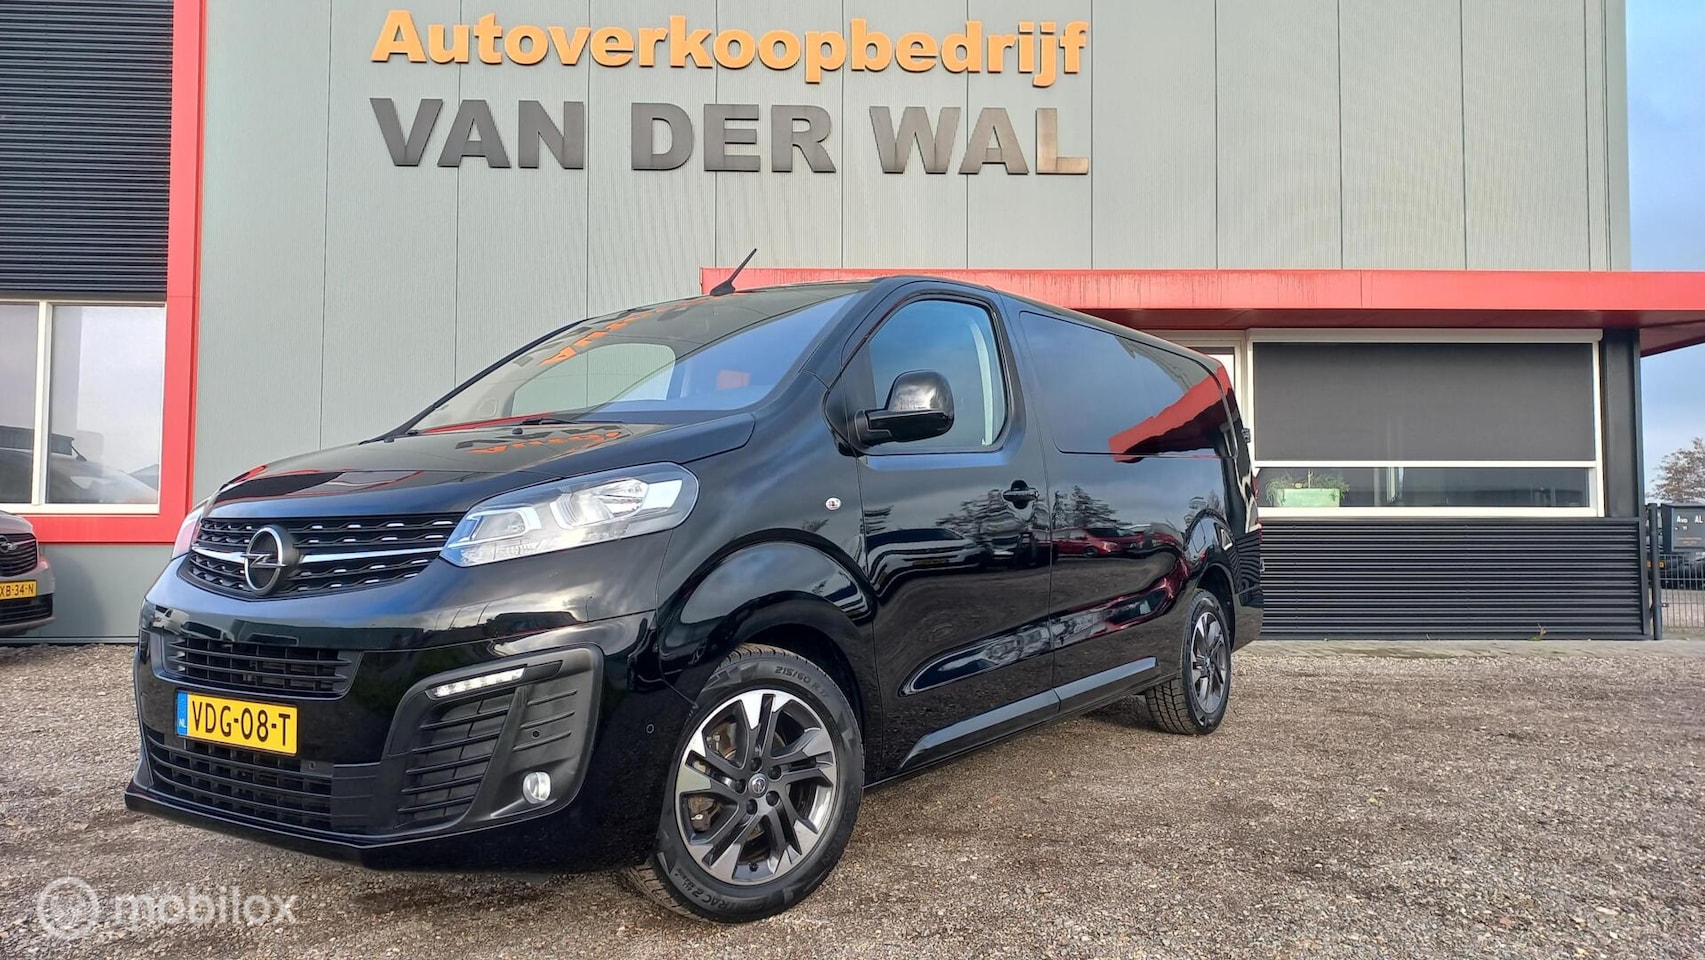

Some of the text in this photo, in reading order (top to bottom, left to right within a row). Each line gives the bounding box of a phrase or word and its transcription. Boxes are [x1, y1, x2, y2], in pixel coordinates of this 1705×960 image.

[371, 10, 1089, 87] Autoverkoopbedrijf
[370, 98, 1089, 175] VAN DER WAL
[775, 666, 811, 683] 215/60
[192, 700, 291, 746] VDG-08-T
